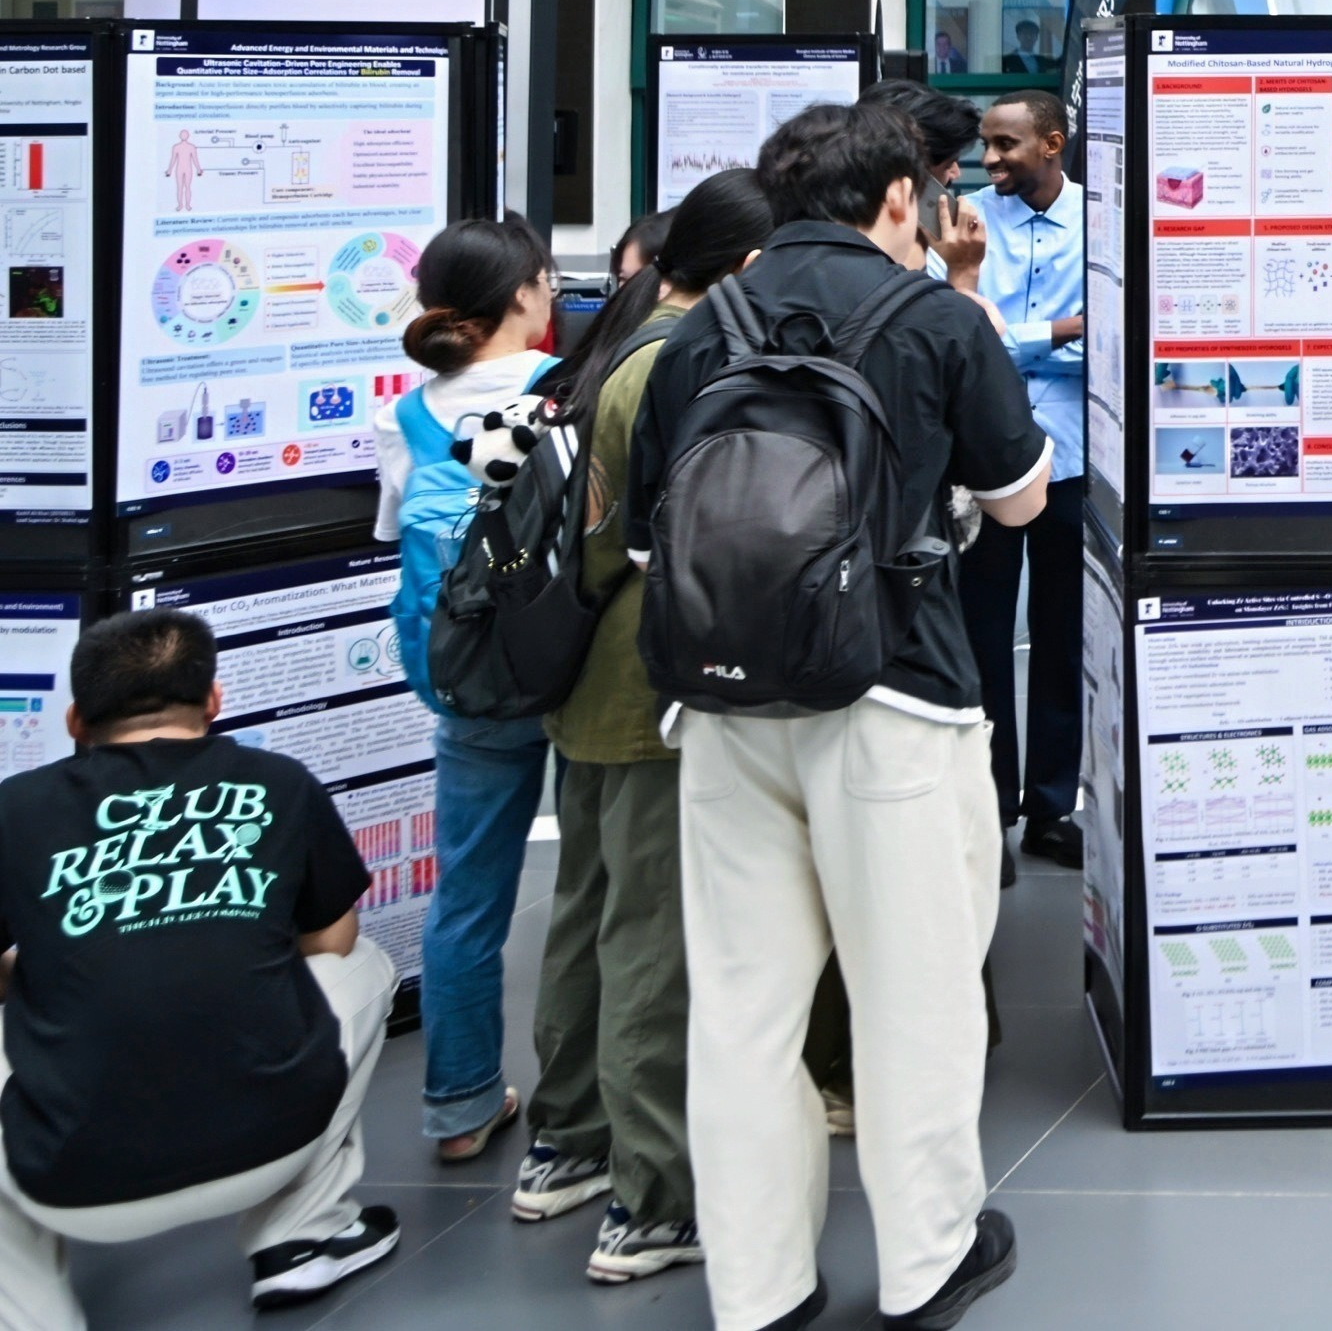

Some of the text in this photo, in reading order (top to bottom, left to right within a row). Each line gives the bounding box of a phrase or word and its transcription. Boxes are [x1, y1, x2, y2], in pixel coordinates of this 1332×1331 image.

[231, 44, 267, 52] Advanced
[269, 45, 293, 54] Energy
[310, 45, 363, 53] Environmental
[364, 46, 398, 54] Materials
[310, 60, 326, 68] Pore
[328, 61, 371, 70] Engineering
[373, 61, 401, 69] Enables
[1274, 59, 1303, 67] Natural
[177, 67, 222, 75] Quantitative
[224, 67, 241, 75] Pore
[304, 68, 347, 76] Correlations
[212, 606, 227, 614] for
[252, 588, 328, 607] Aromatization:
[332, 581, 357, 592] What
[360, 574, 396, 588] Matters
[703, 664, 746, 680] FILA
[97, 782, 273, 830] CLUB,
[41, 822, 262, 897] RELAX
[114, 866, 278, 920] PLAY
